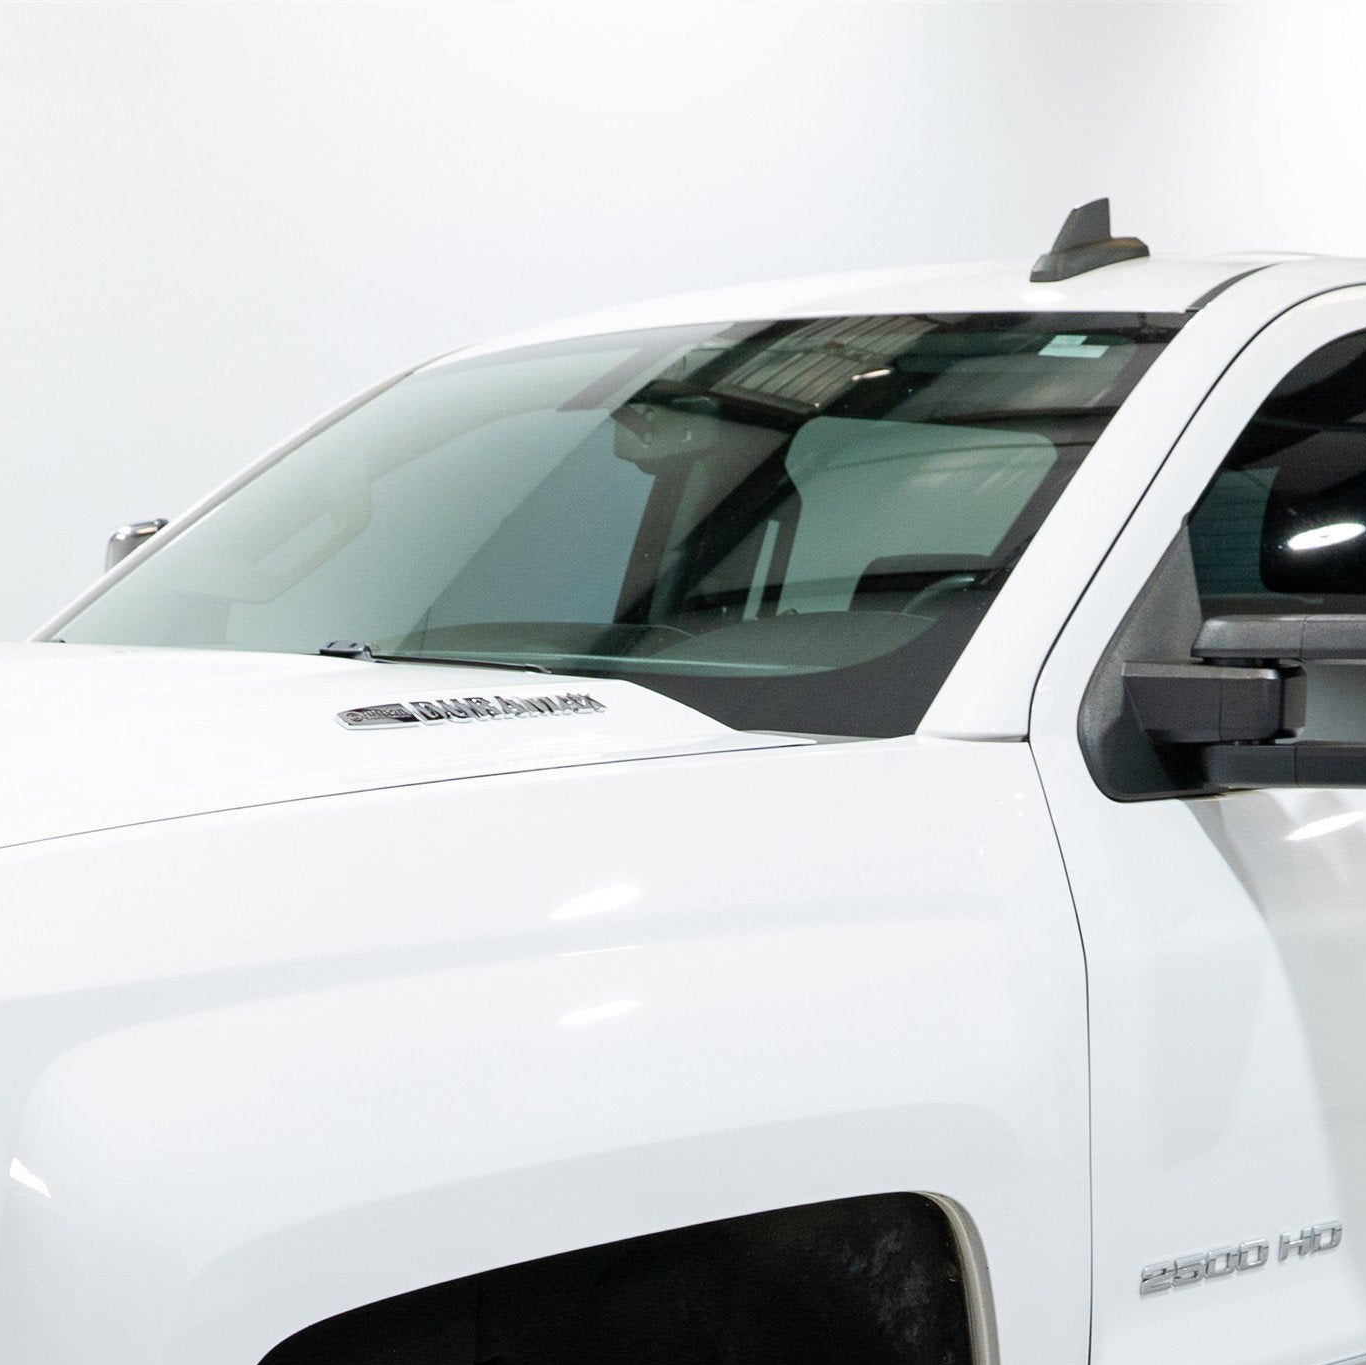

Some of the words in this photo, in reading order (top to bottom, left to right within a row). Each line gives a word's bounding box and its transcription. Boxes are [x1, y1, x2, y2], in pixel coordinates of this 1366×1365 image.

[409, 691, 607, 723] DURAMAX
[1139, 1238, 1270, 1297] 2500
[1278, 1220, 1343, 1264] HD
